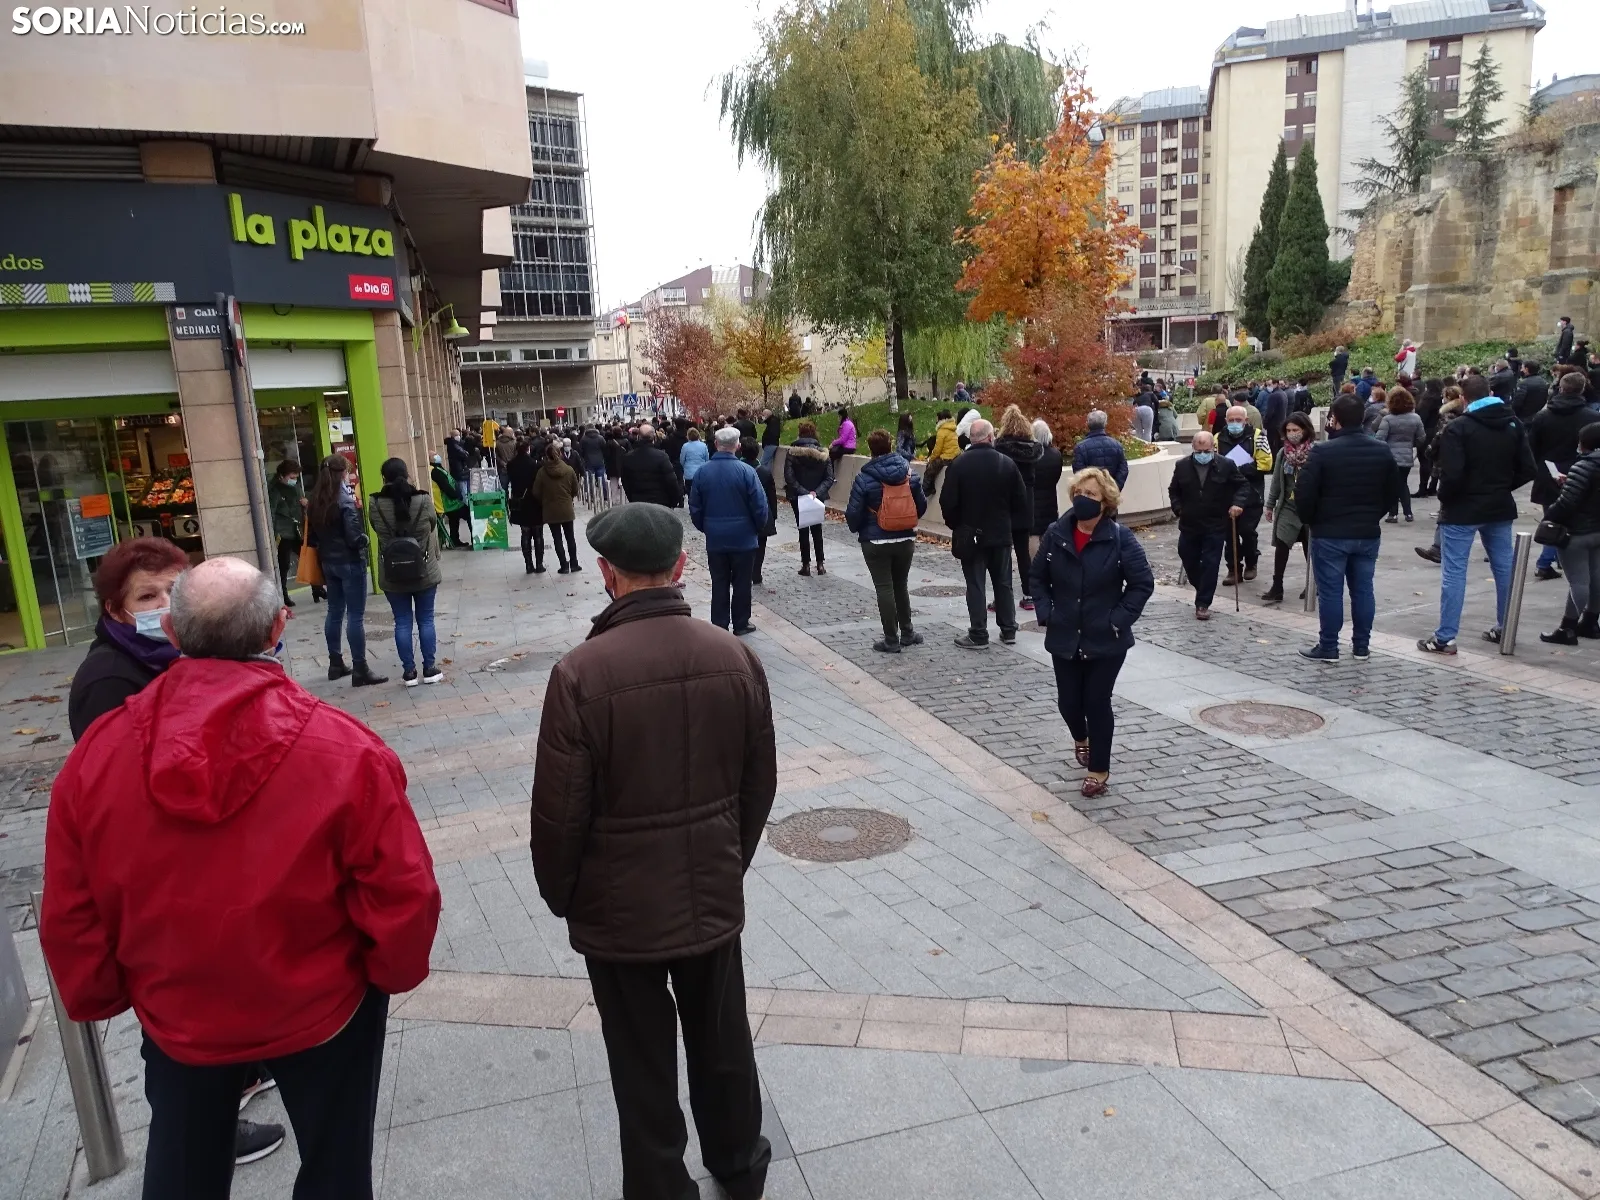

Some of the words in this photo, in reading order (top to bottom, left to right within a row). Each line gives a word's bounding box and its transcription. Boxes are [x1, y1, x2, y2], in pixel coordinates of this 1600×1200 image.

[228, 192, 276, 245] la
[288, 205, 395, 260] plaza
[0, 253, 44, 270] dos
[194, 308, 218, 317] Call
